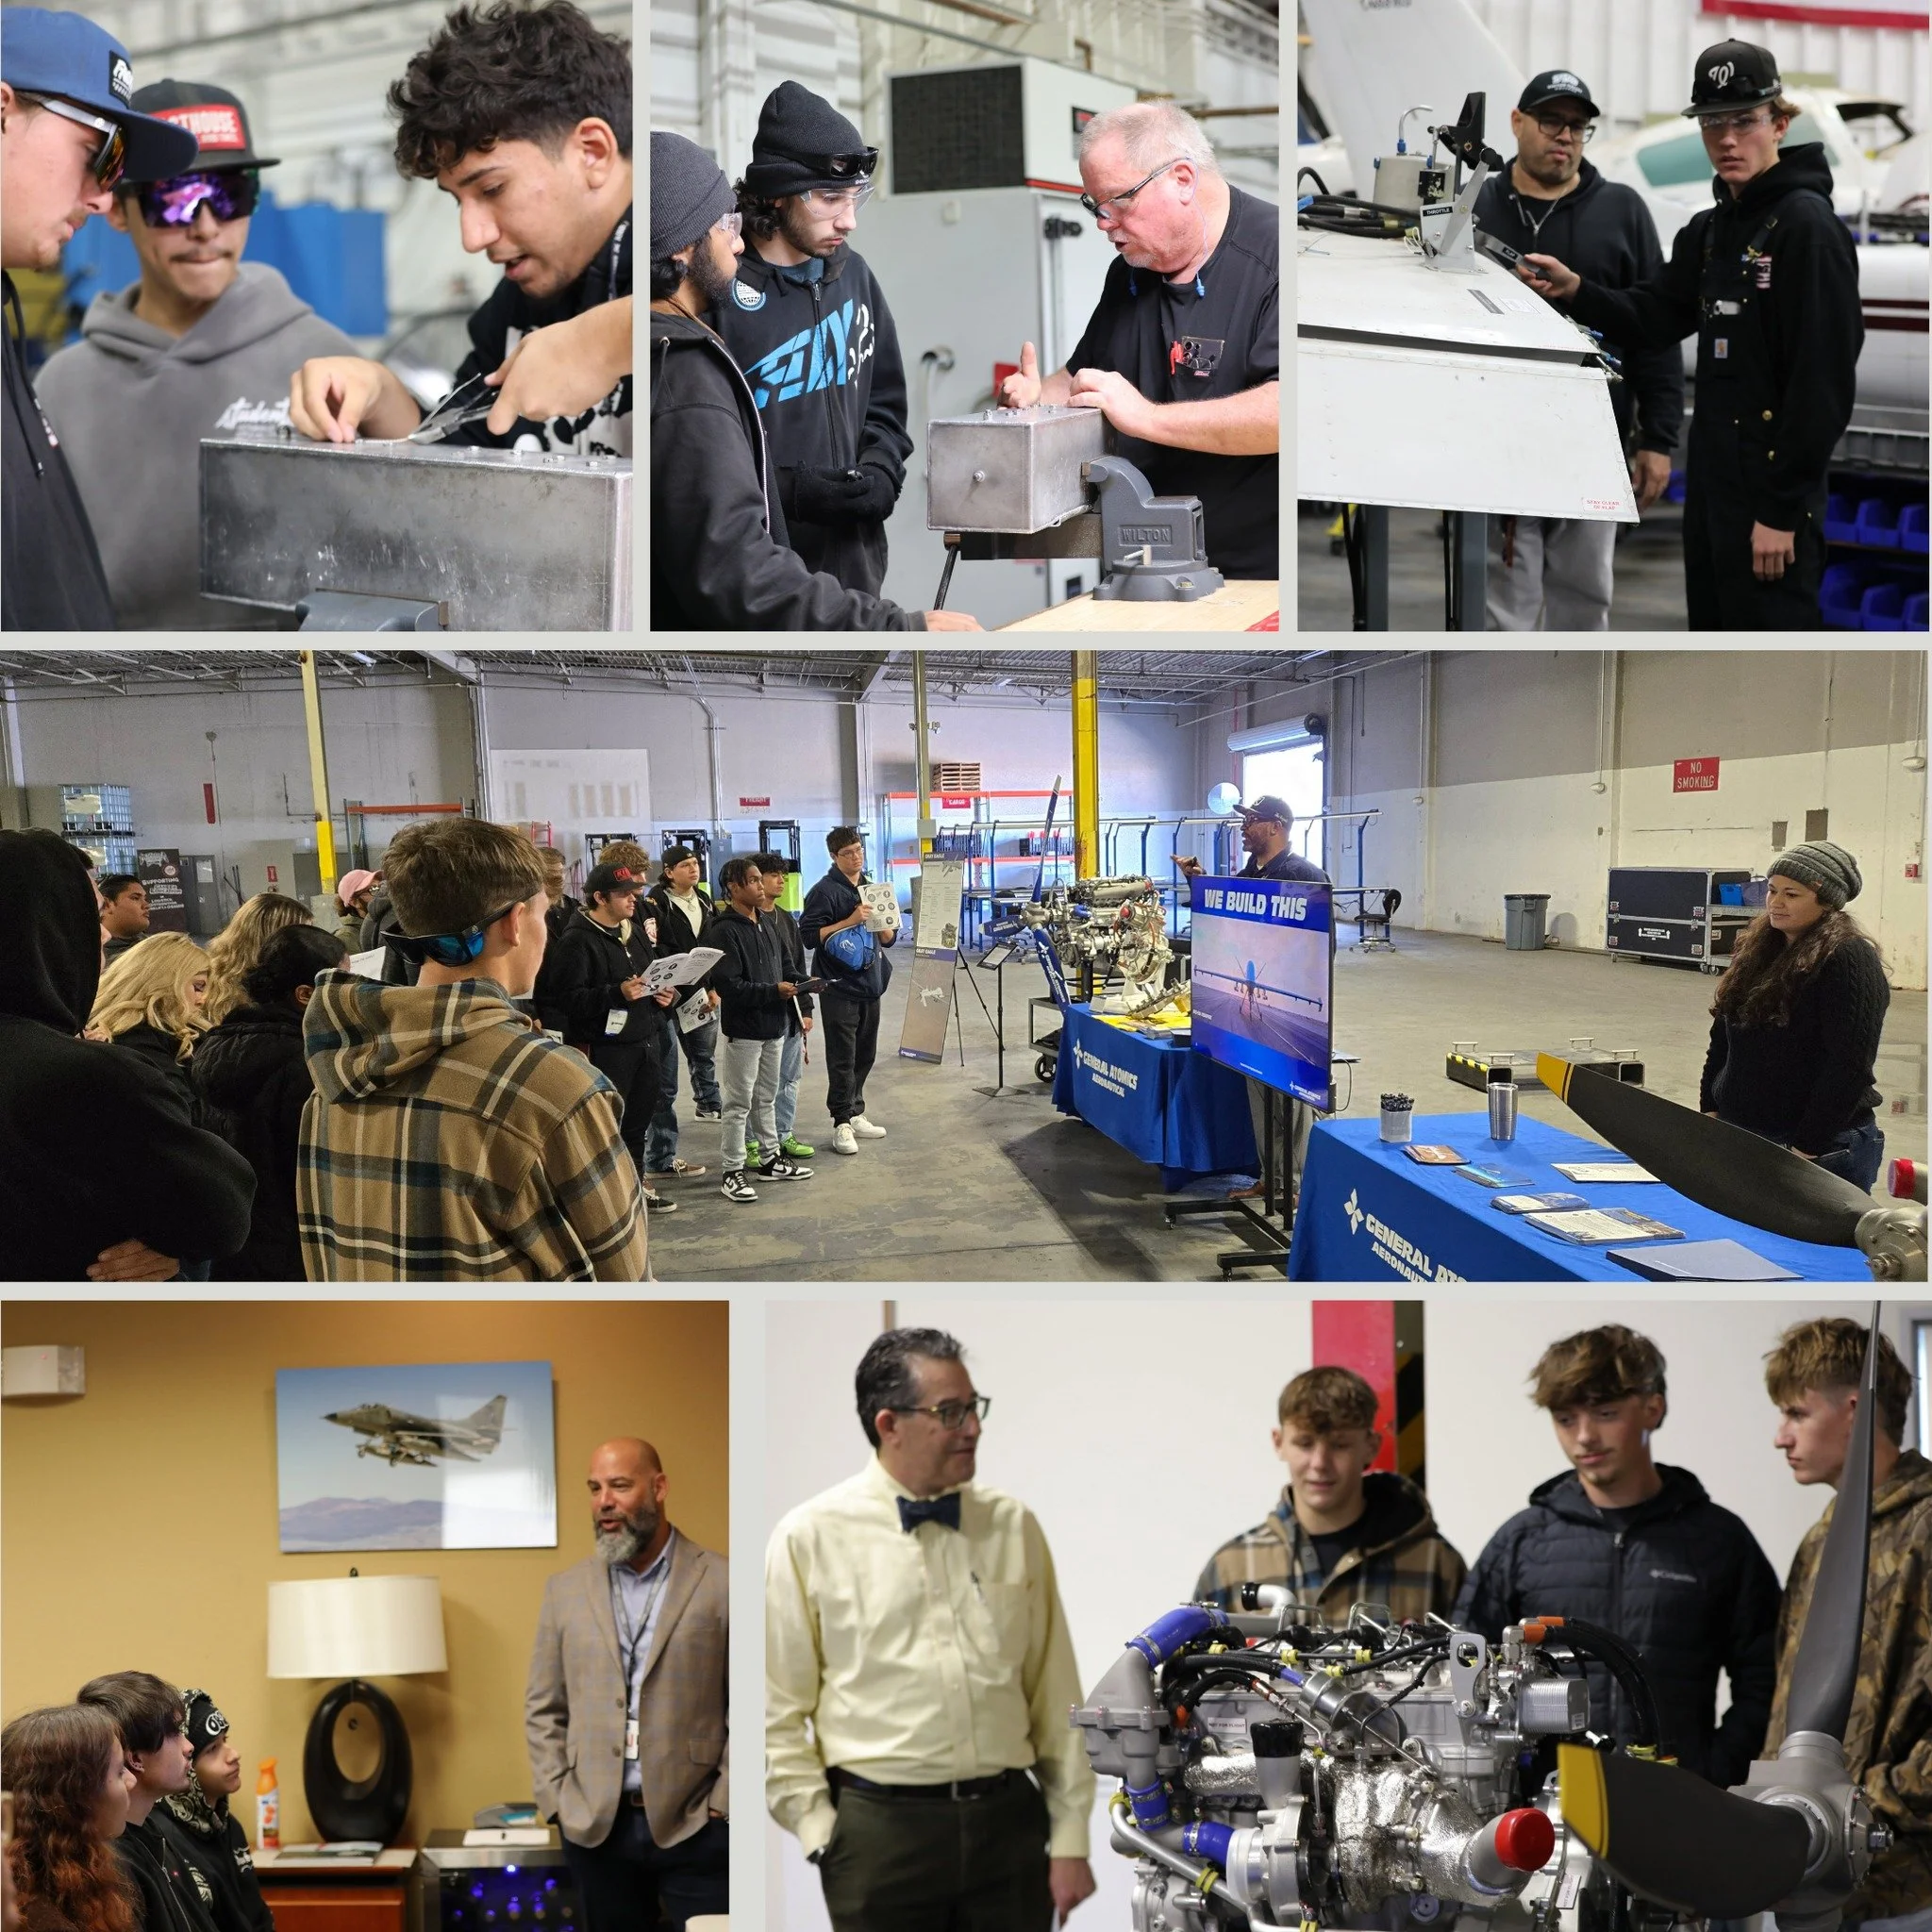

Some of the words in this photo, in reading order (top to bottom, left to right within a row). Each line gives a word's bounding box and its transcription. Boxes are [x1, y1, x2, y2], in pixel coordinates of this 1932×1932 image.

[1425, 207, 1450, 215] THROTTLE
[1121, 528, 1170, 542] WILTON
[1690, 761, 1702, 774] NO
[1676, 774, 1715, 789] SMOKING
[142, 877, 179, 886] SUPPORTING
[1204, 889, 1224, 909] WE
[1225, 890, 1267, 915] BUILD
[1271, 895, 1307, 922] THIS
[1083, 1051, 1108, 1076] GENERAL
[1109, 1064, 1138, 1091] ATOMICS
[1092, 1073, 1124, 1098] AERONAUTICAL
[1365, 1213, 1433, 1277] GENERAL
